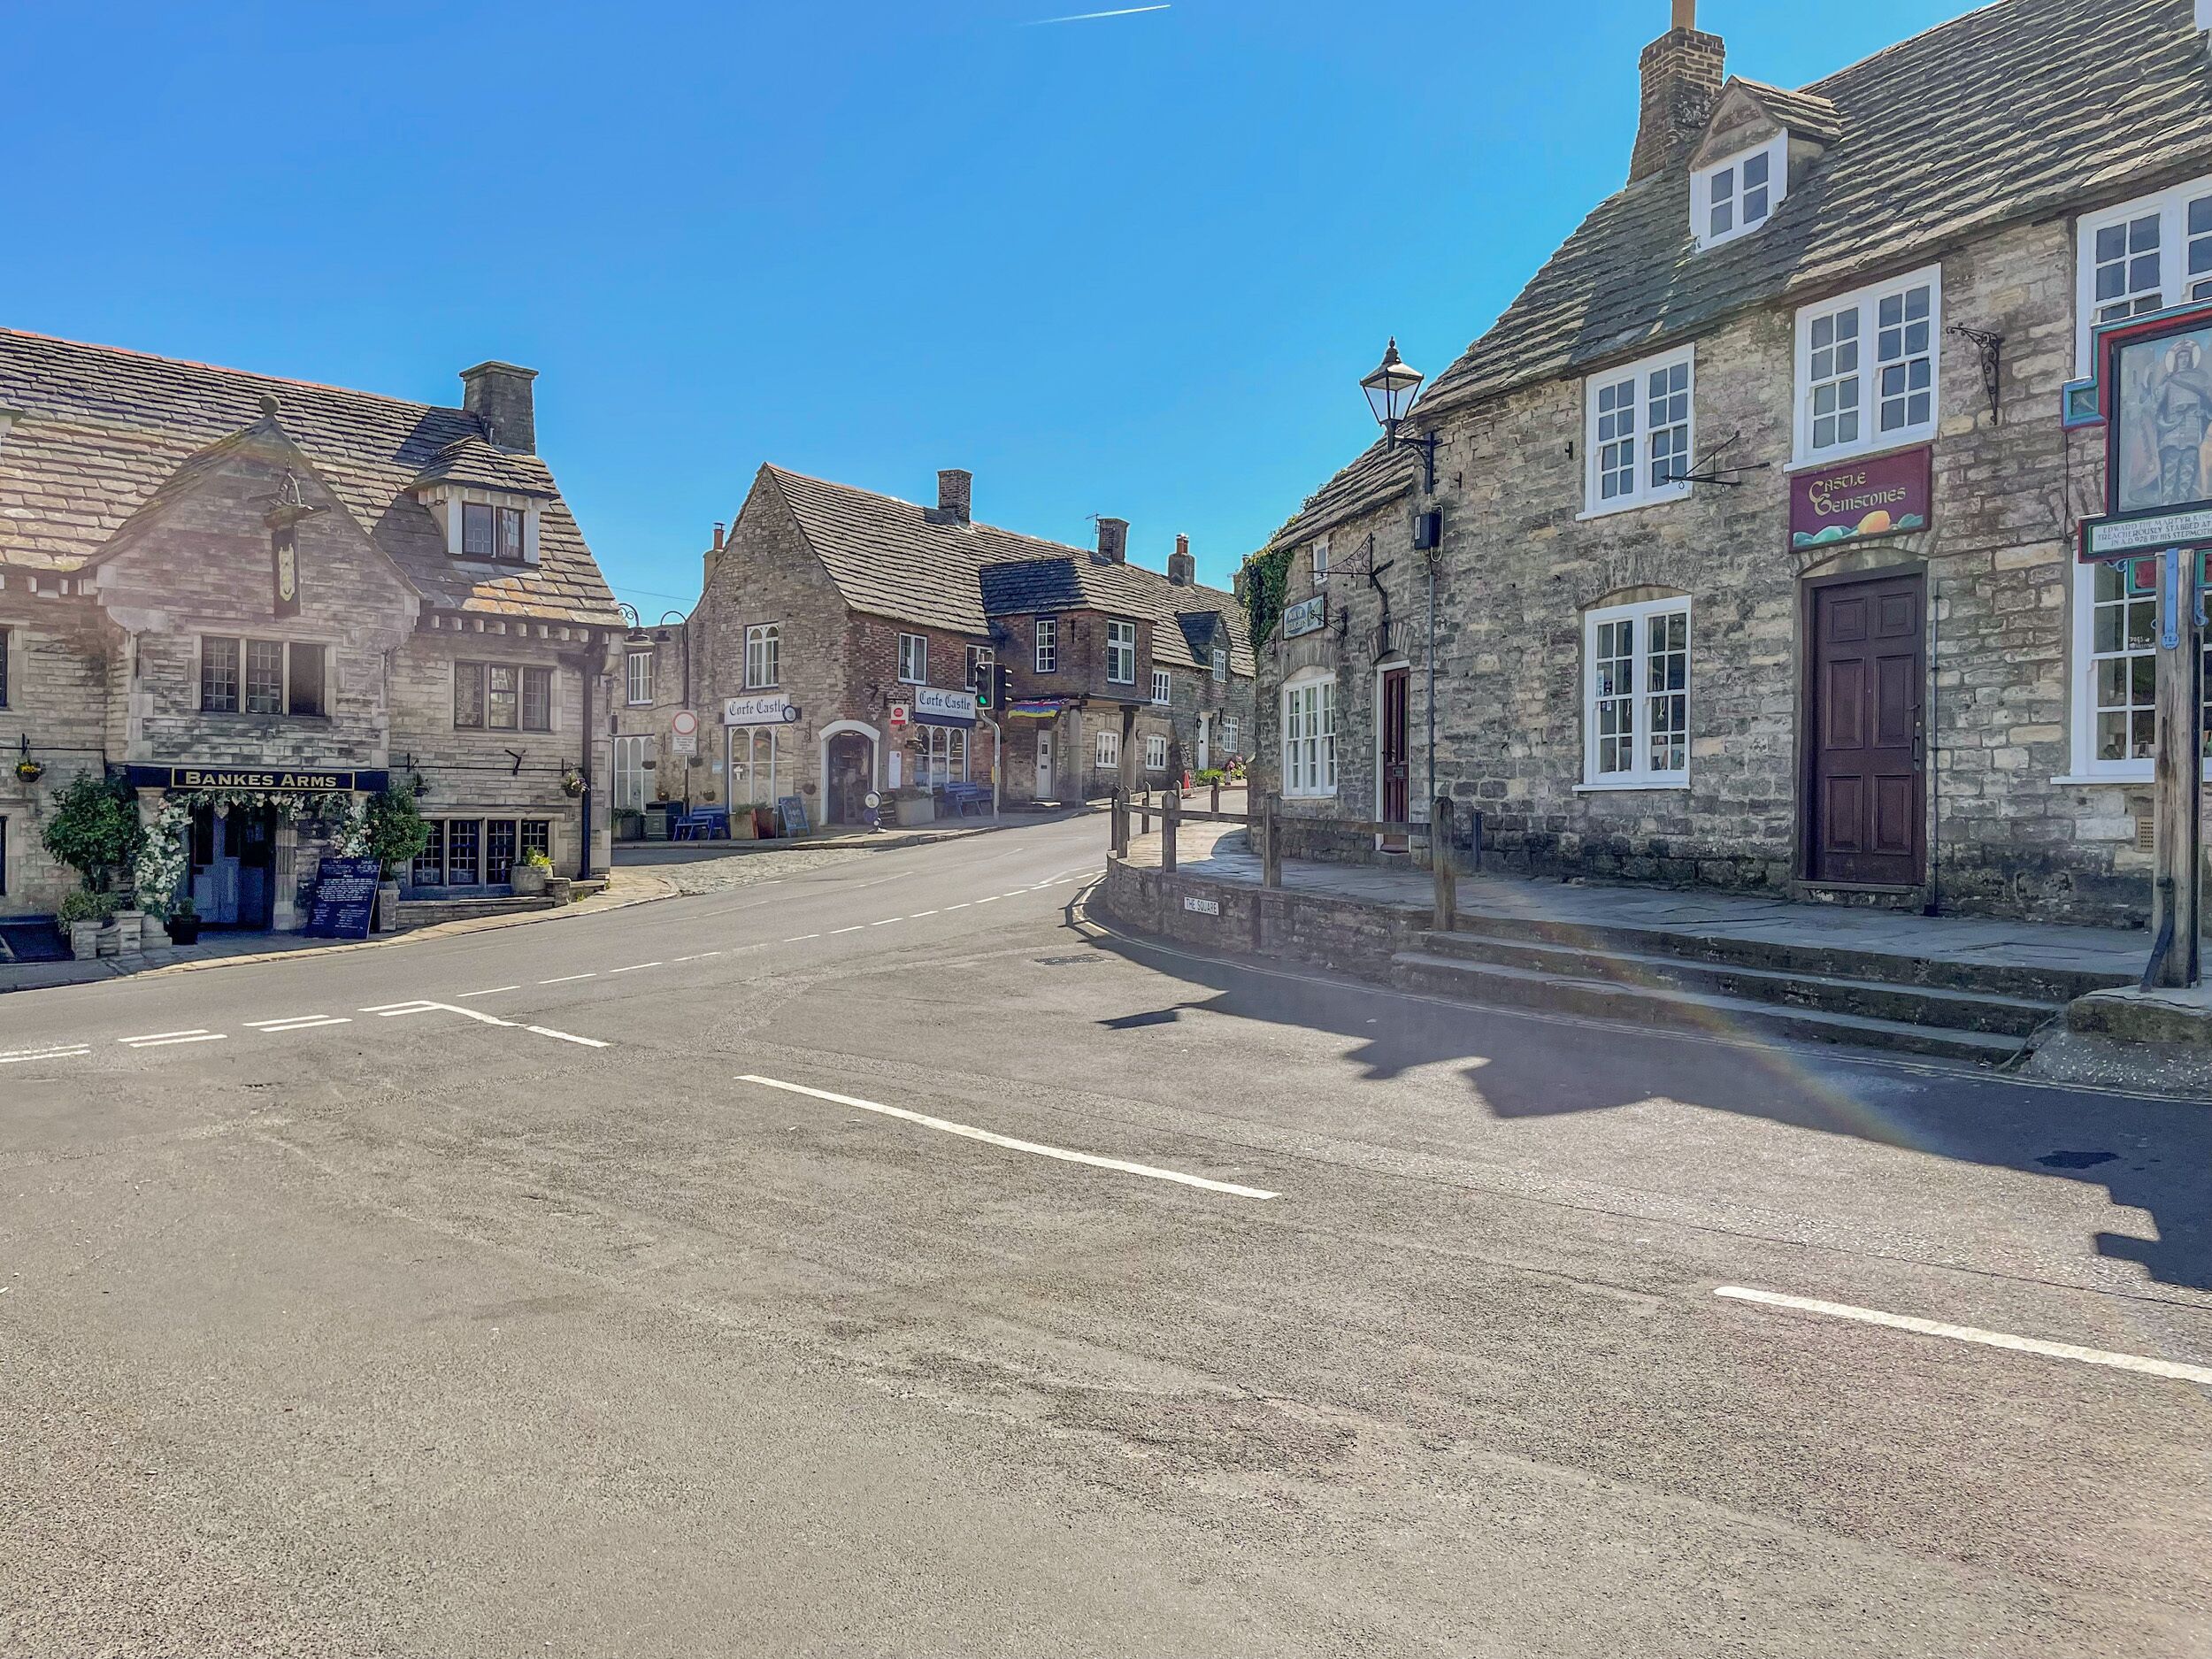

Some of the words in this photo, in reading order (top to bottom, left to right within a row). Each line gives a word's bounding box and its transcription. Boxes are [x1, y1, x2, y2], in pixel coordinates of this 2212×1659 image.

[2098, 527, 2162, 541] TREACHEROUSLY
[2166, 522, 2199, 532] STABBED
[2103, 523, 2138, 533] EDWARD
[2155, 517, 2190, 526] MARTYR
[729, 701, 754, 716] Corfe
[757, 698, 786, 713] Castle
[919, 690, 943, 707] Corfe
[945, 694, 971, 710] Castle
[186, 772, 274, 786] BANKES
[280, 773, 336, 787] ARMS
[1187, 898, 1195, 910] THE
[1197, 900, 1217, 914] SQUARE
